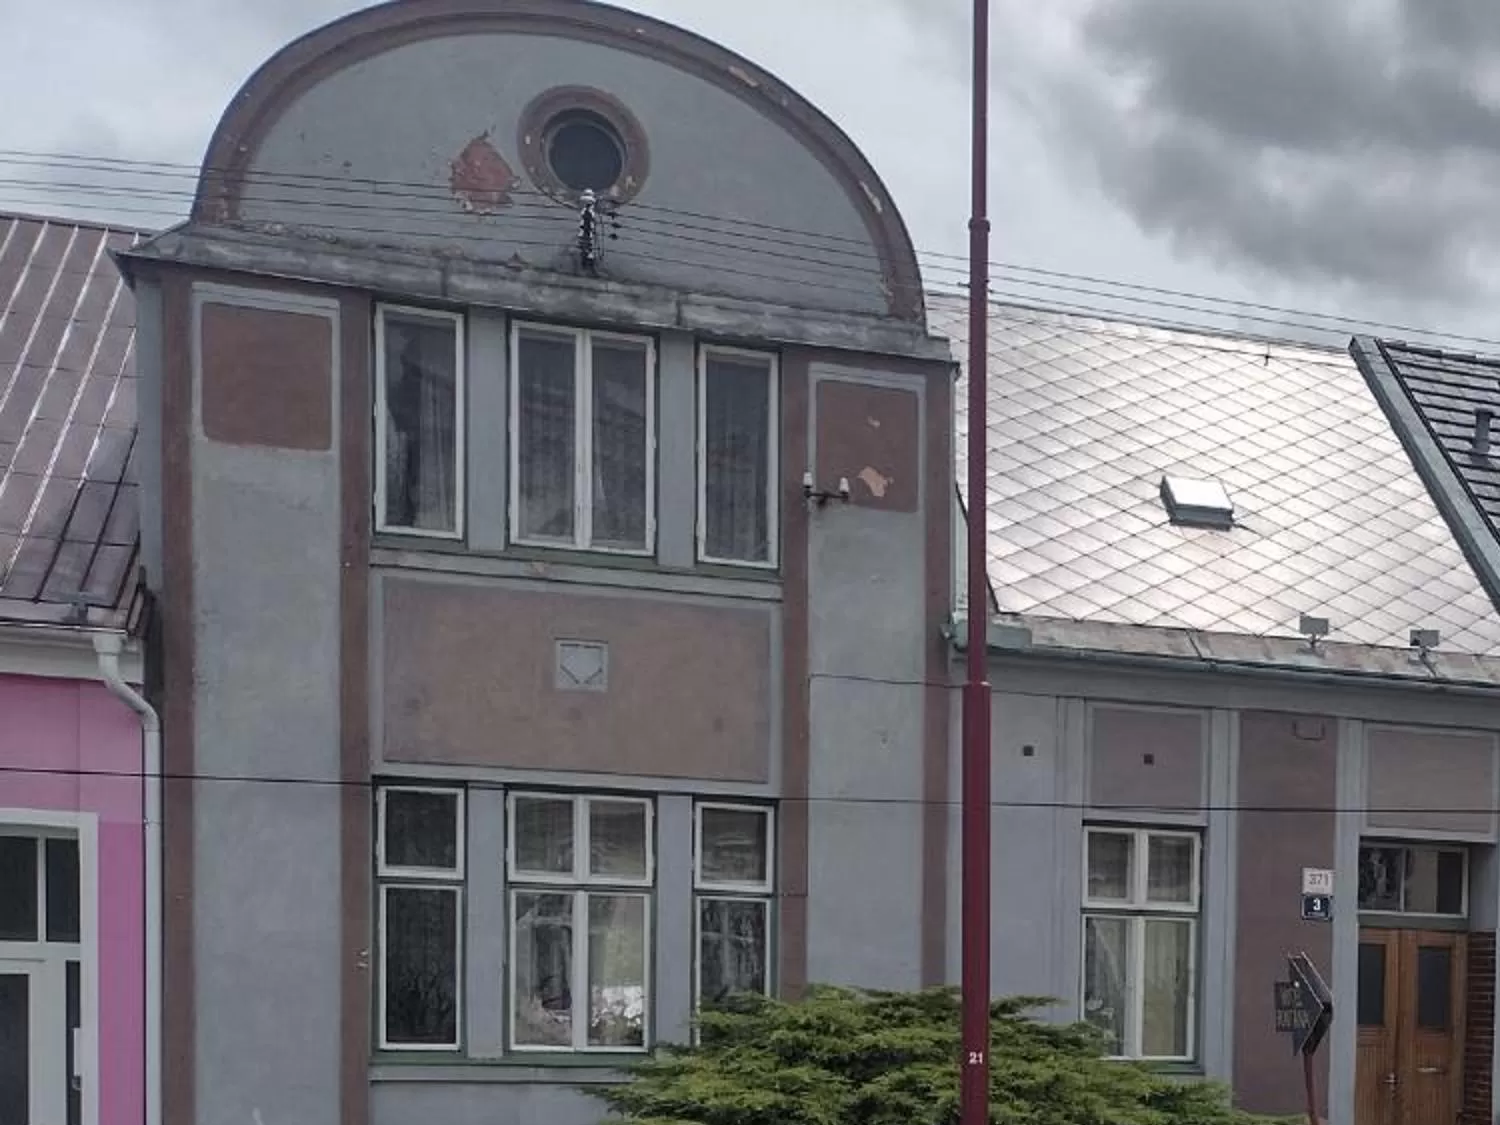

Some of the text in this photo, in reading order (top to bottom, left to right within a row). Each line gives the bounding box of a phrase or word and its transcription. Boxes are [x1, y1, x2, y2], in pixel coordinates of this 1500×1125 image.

[1308, 872, 1329, 887] 371
[1312, 897, 1321, 911] 3
[969, 1051, 983, 1065] 21
